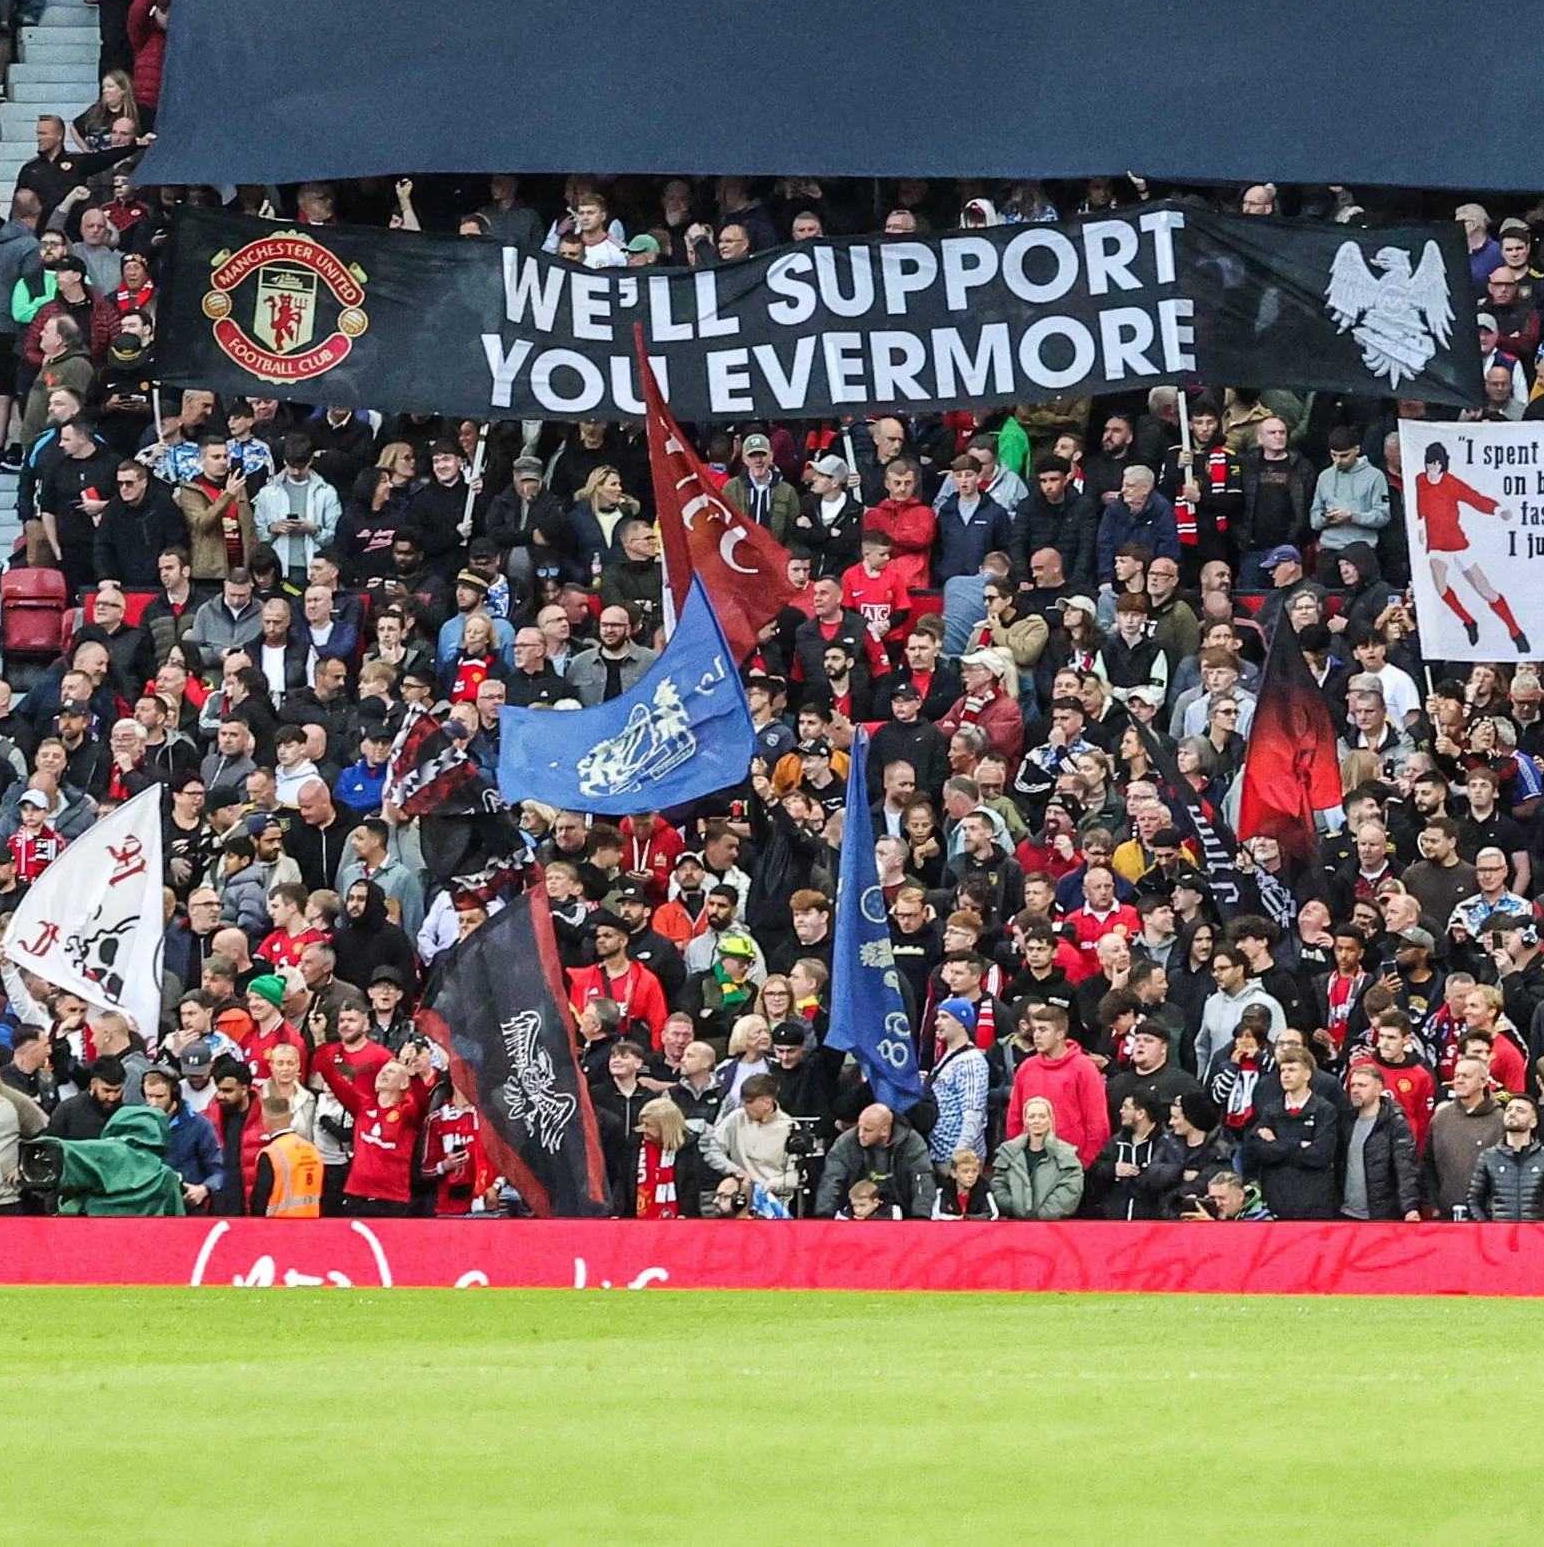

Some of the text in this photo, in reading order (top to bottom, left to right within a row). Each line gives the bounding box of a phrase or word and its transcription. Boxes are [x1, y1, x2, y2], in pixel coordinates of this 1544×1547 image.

[218, 242, 356, 301] MANCHESTER UNITED
[500, 208, 1187, 344] WE'LL SUPPORT
[228, 337, 334, 375] FOOTBALL CLUB
[481, 298, 1198, 415] YOU EVERMORE
[1483, 440, 1538, 468] spent
[1503, 474, 1527, 495] on
[1508, 531, 1516, 557] I
[865, 605, 890, 624] AIG
